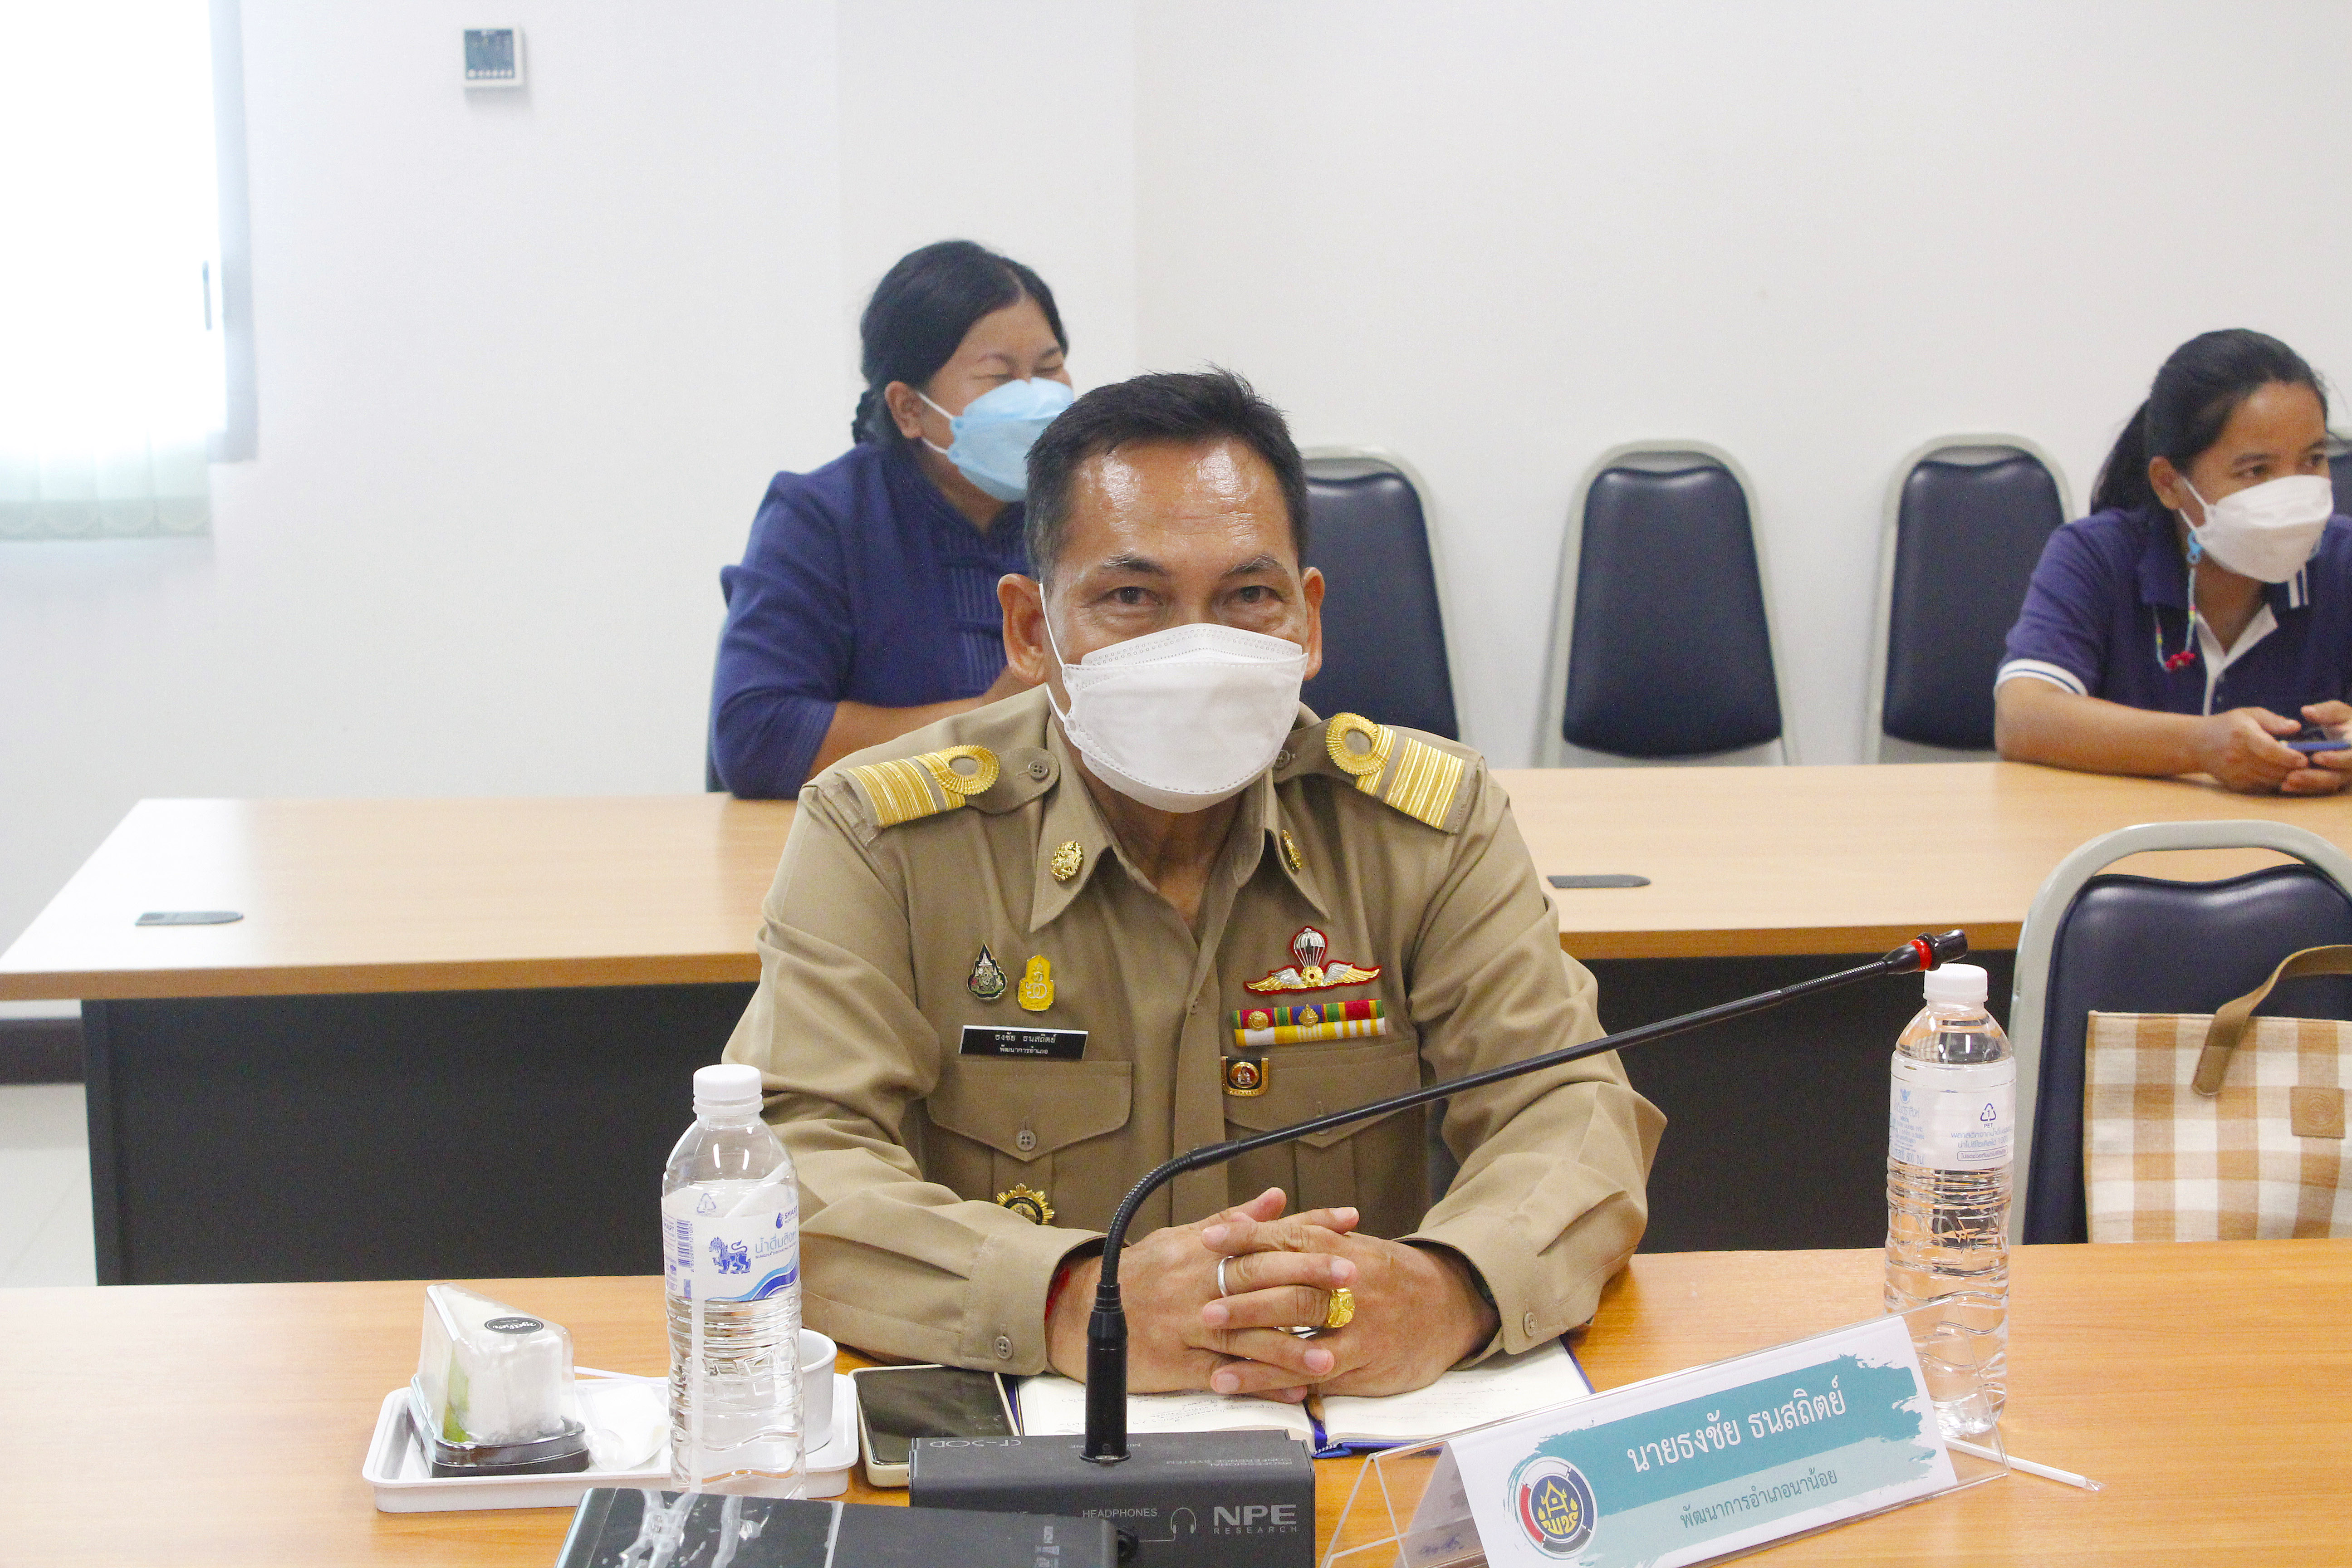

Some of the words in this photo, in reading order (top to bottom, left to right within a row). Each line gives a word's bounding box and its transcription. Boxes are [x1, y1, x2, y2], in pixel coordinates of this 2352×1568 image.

[995, 1031, 1016, 1041] ธงชัย
[1023, 1033, 1057, 1043] ธนสถิตย์
[1627, 1409, 1741, 1473] นายธงชัย
[1748, 1374, 1846, 1438] ธนสถิตย์
[1680, 1467, 1838, 1529] พัฒนาการอำเภอนาน้อย
[1083, 1508, 1157, 1518] HEADPHONES
[1214, 1504, 1296, 1526] NPE
[1214, 1526, 1297, 1534] RESEARCH
